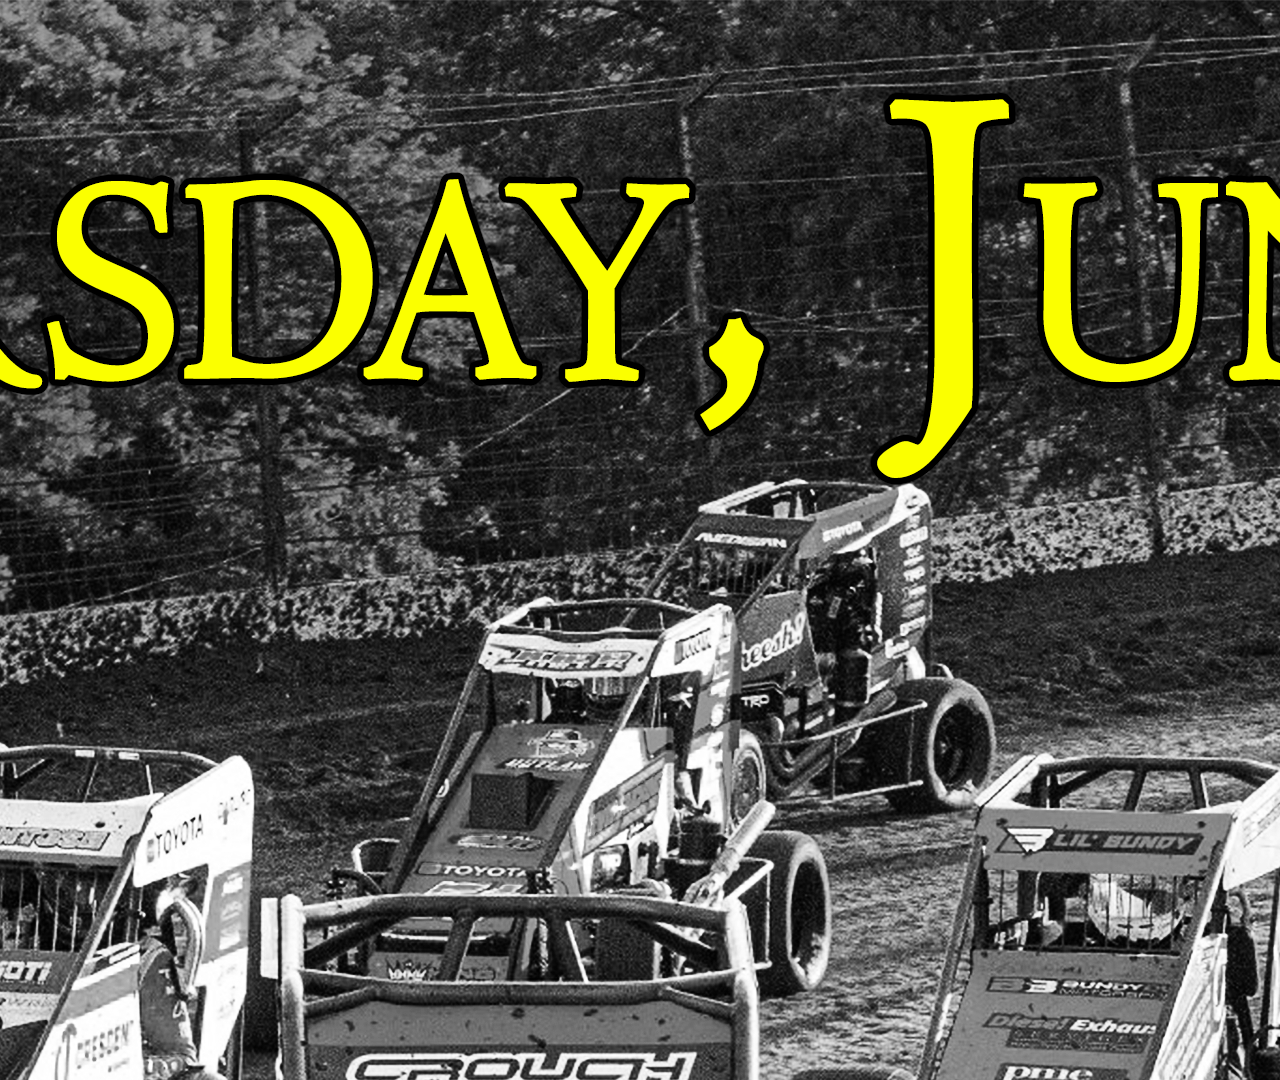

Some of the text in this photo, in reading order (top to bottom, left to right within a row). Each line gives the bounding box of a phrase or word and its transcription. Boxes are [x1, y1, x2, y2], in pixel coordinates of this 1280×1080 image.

[154, 813, 204, 858] TOYOTA
[1102, 834, 1196, 851] BUNDY
[443, 865, 527, 877] TOYOTA
[1070, 1019, 1157, 1035] Exhaus
